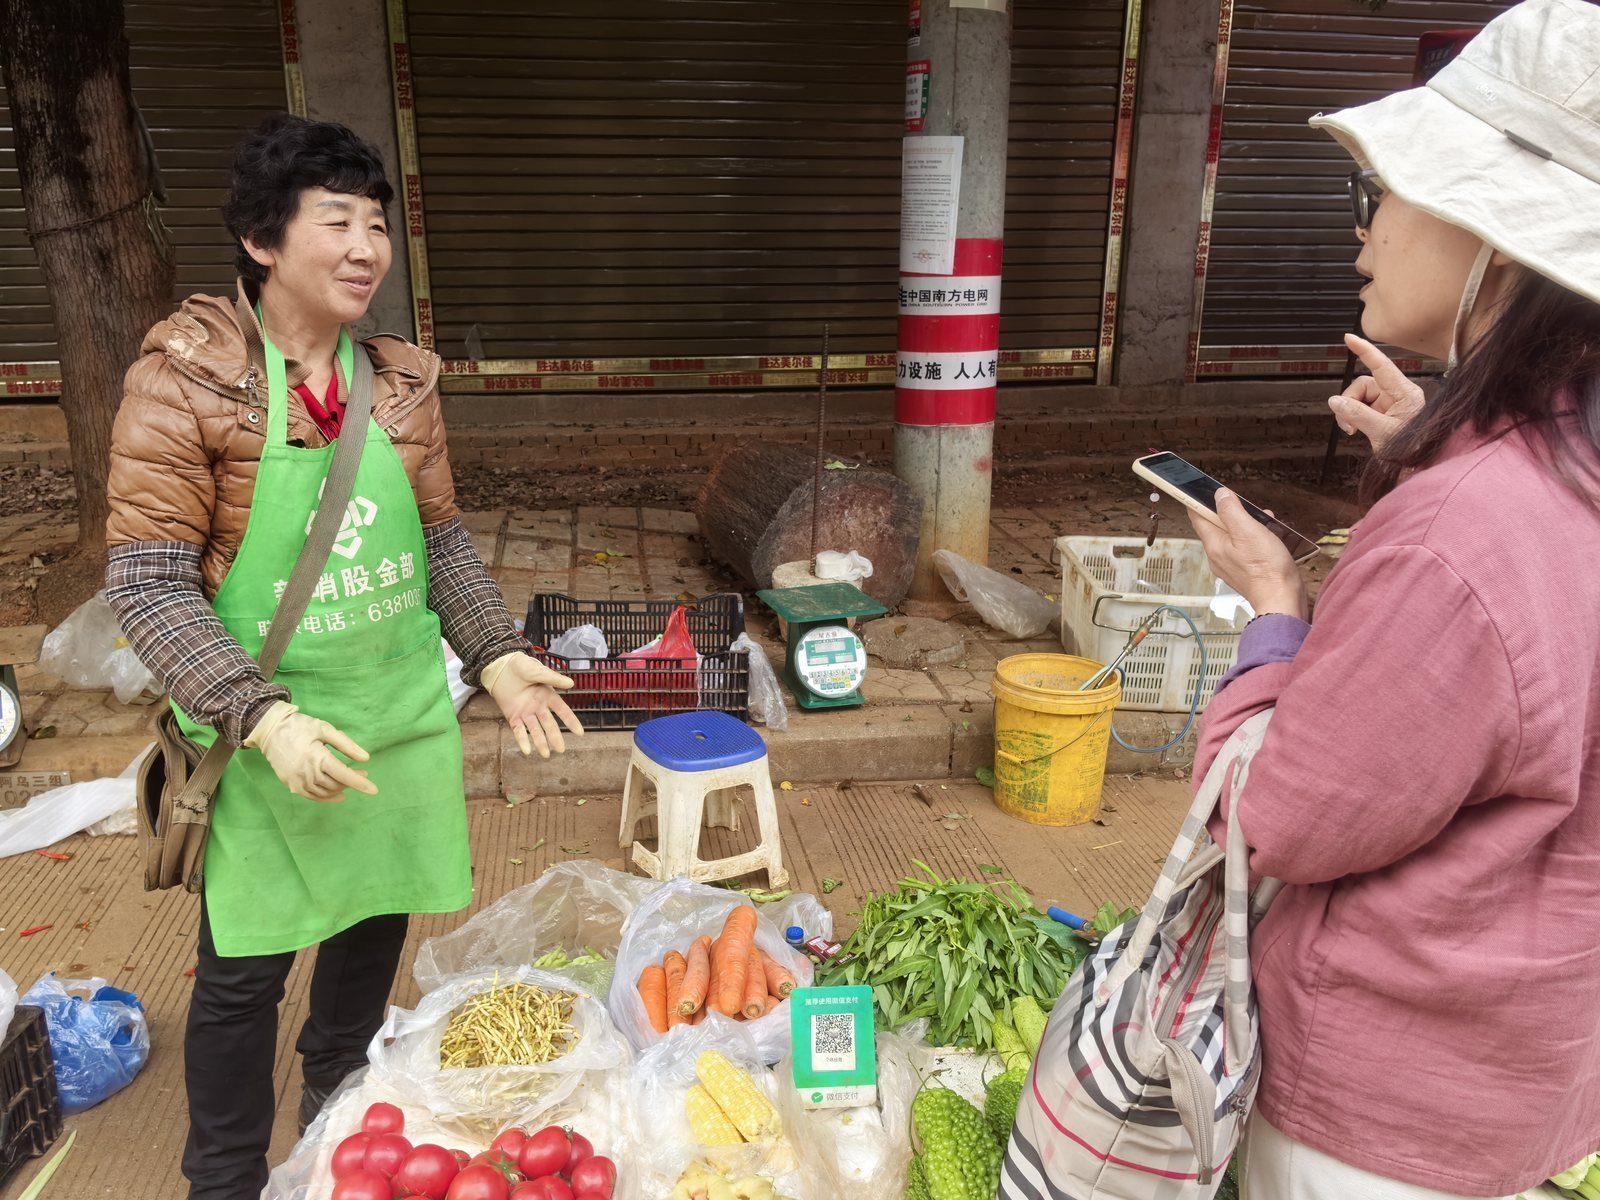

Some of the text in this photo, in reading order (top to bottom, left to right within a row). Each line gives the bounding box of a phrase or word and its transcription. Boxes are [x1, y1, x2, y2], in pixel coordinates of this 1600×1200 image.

[393, 42, 413, 110] 胜达美尔佳
[1120, 58, 1136, 120] 胜达美尔佳
[405, 174, 424, 238] 胜达美尔佳
[1110, 178, 1127, 237] 胜达美尔佳
[908, 289, 988, 303] 中国南方电网
[1101, 292, 1117, 347] 胜达美尔佳
[536, 359, 594, 372] 胜达美尔佳
[758, 356, 813, 369] 胜达美尔佳
[897, 359, 997, 380] 力设施 人人有
[805, 996, 860, 1006] 推荐使用微信支付
[827, 1092, 859, 1101] 微信支付
